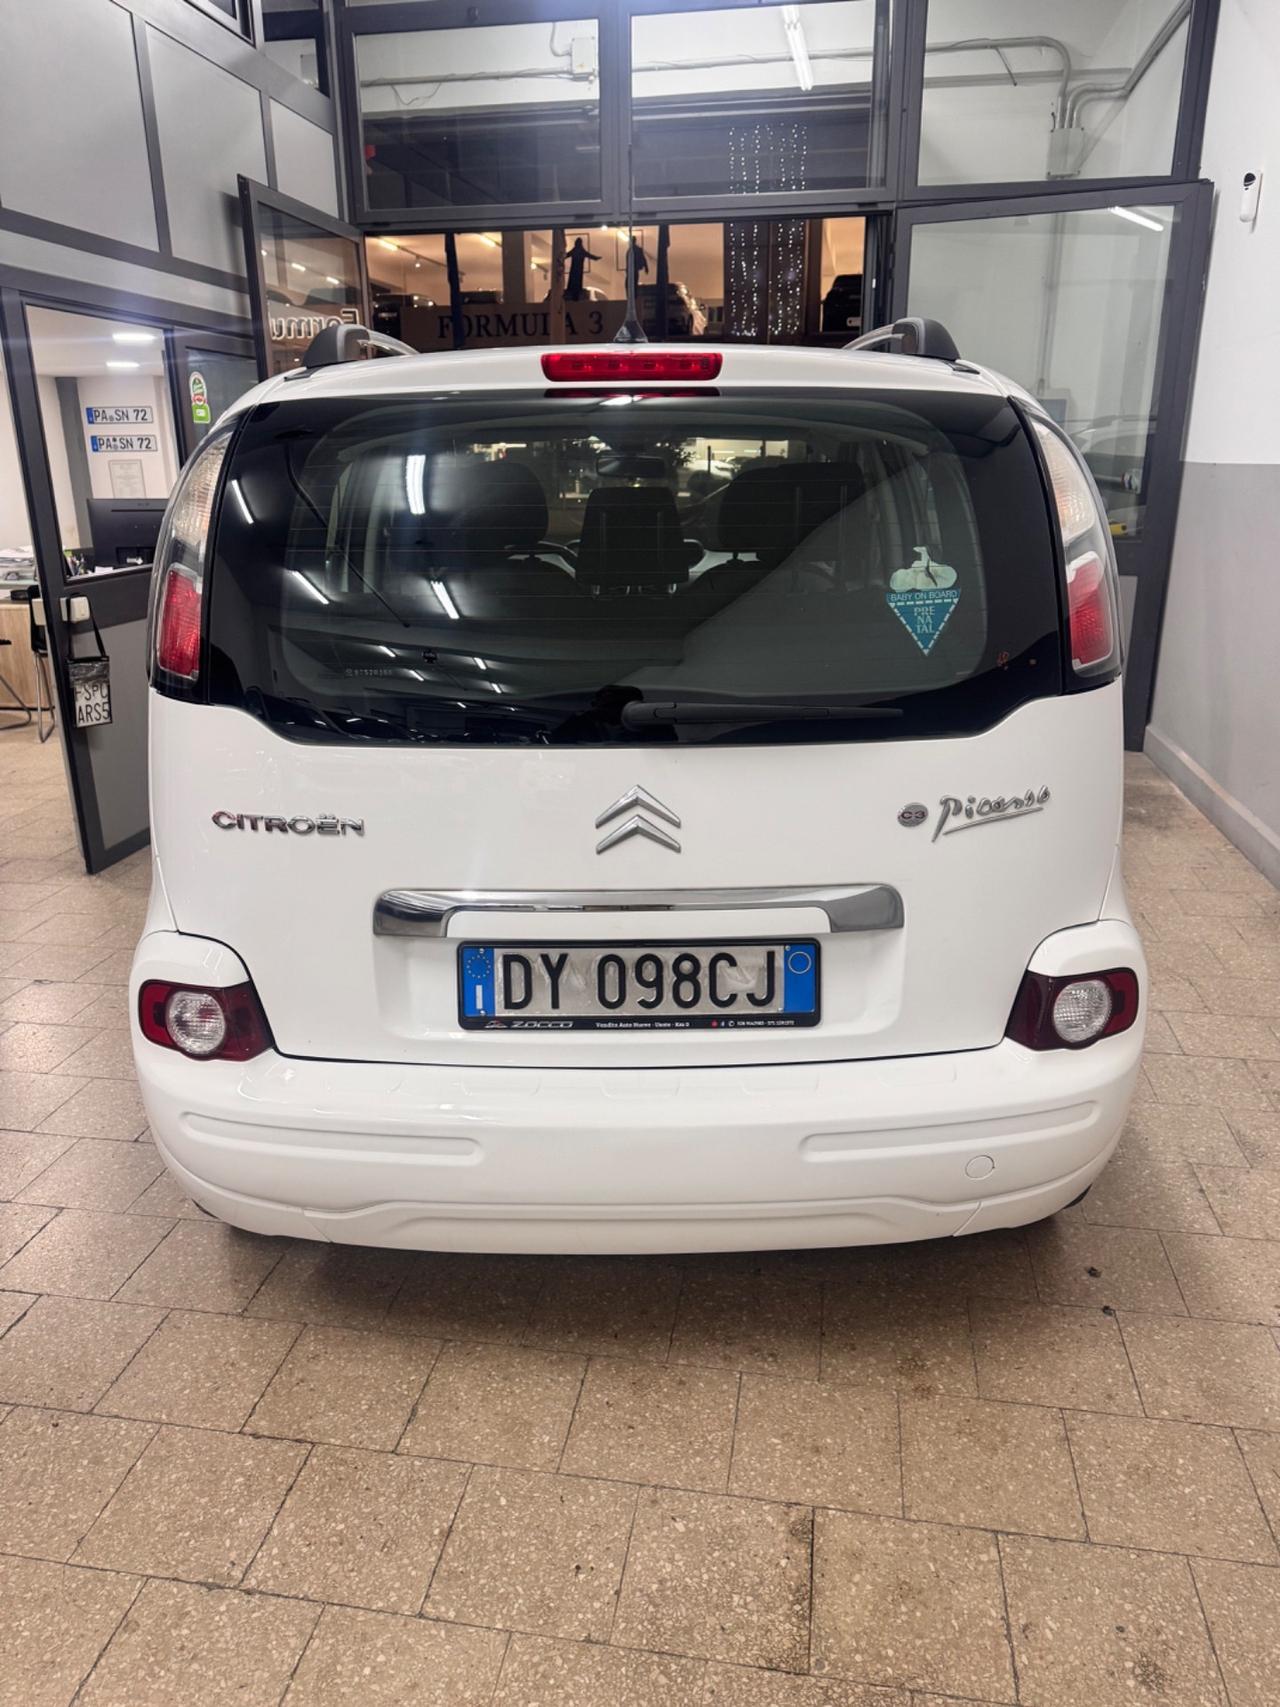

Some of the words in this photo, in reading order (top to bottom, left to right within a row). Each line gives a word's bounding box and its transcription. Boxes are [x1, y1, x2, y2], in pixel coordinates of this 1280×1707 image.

[589, 310, 604, 335] 3
[94, 409, 108, 422] PA
[114, 408, 130, 422] SN
[133, 408, 149, 421] 72
[98, 437, 112, 450] PA
[119, 437, 134, 450] SN
[137, 437, 152, 450] 72
[890, 593, 913, 602] BABY
[914, 592, 927, 601] ON
[929, 590, 958, 600] BOARD
[913, 606, 936, 616] PRE
[917, 615, 933, 625] NA
[916, 624, 935, 634] TAL
[931, 784, 1051, 843] Picasso
[211, 810, 365, 837] CITROËN
[502, 952, 569, 1010] DY
[597, 950, 776, 1010] 098CJ
